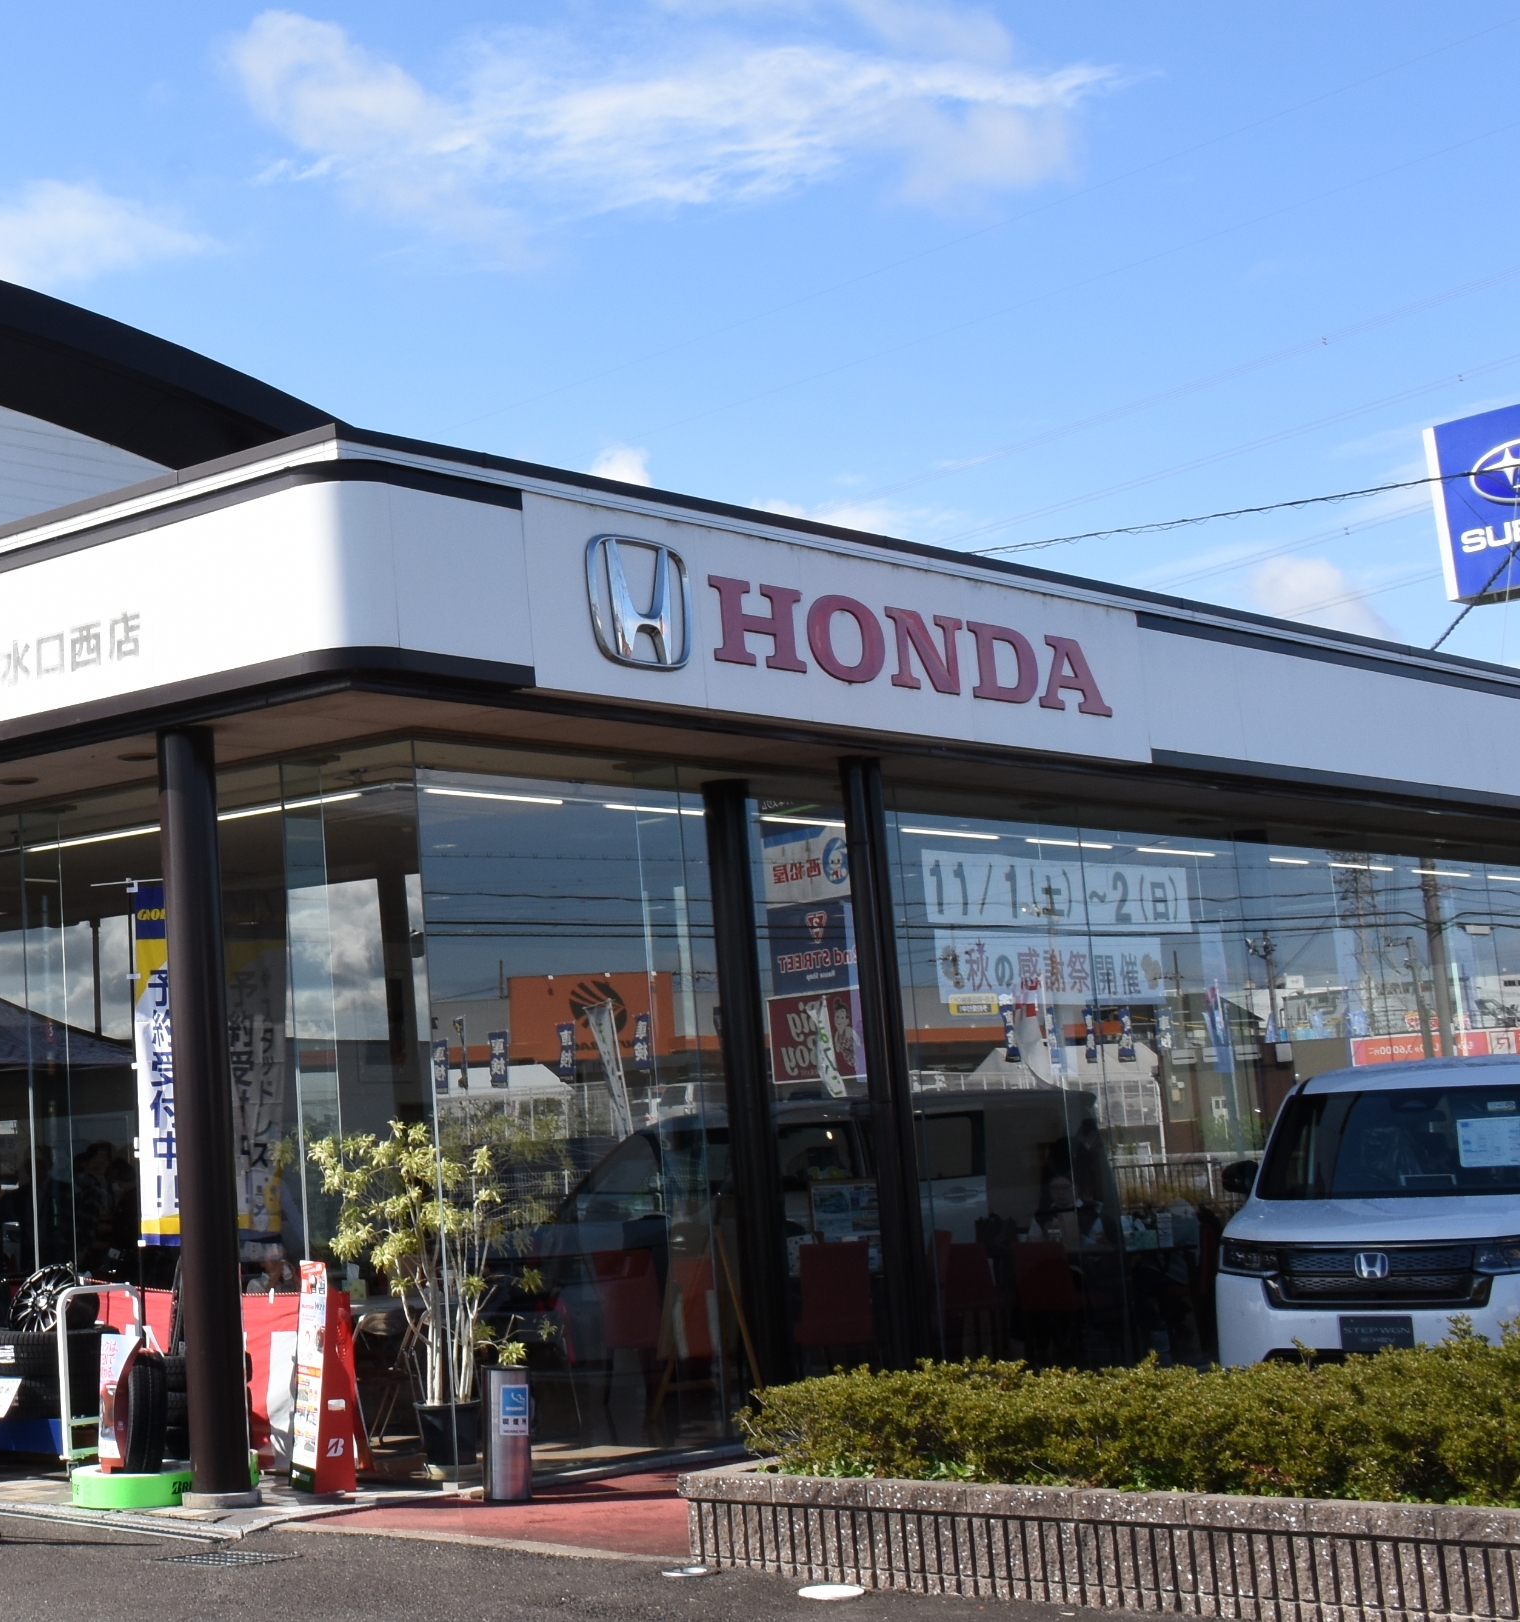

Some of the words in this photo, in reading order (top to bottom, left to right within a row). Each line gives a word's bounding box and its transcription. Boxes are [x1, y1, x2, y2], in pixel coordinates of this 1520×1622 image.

[0, 611, 141, 688] 水口西店
[707, 573, 1113, 718] HONDA
[965, 937, 1142, 996] 秋の感謝祭開催
